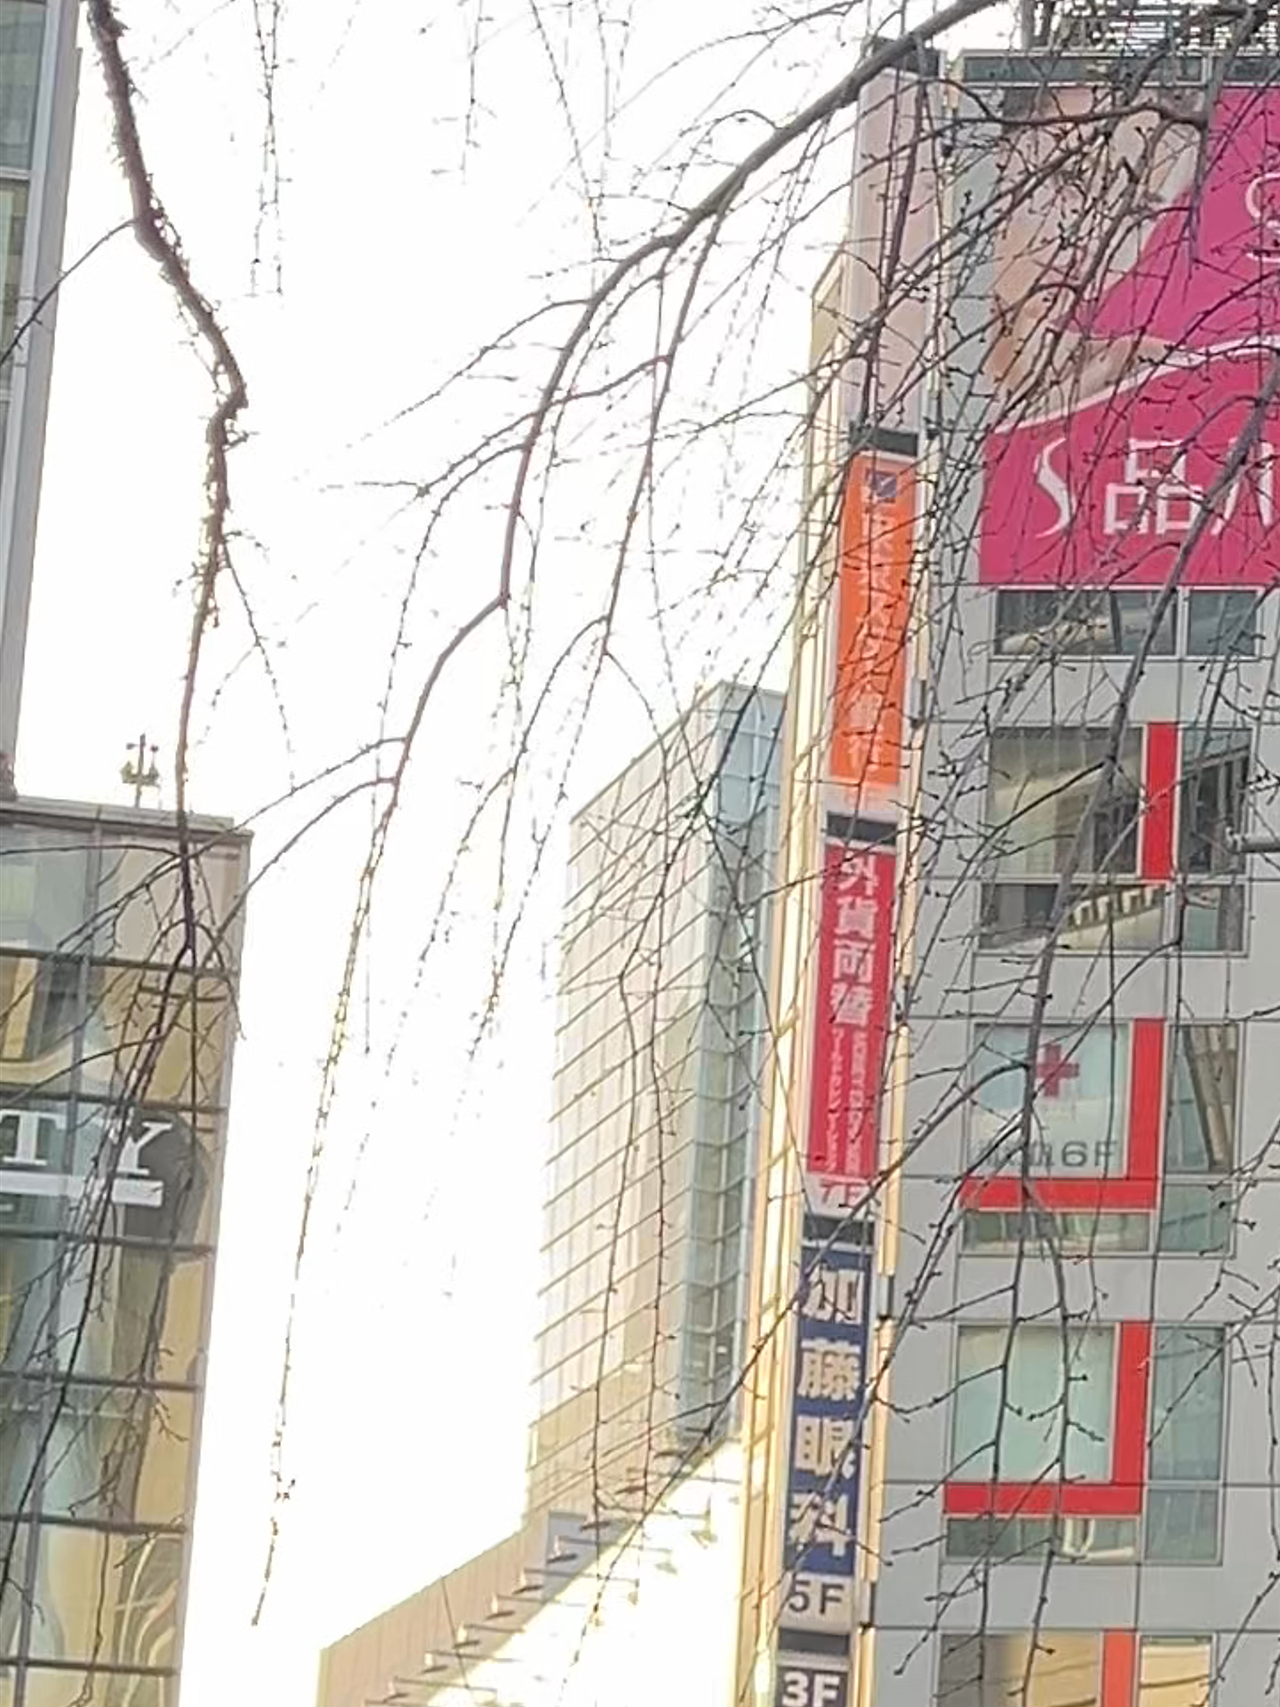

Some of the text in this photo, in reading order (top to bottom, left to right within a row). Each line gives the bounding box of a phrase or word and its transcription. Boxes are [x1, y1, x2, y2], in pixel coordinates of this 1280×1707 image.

[830, 854, 880, 1028] 外貨両替
[788, 1268, 866, 1556] 加藤眼科
[788, 1580, 845, 1616] 5F
